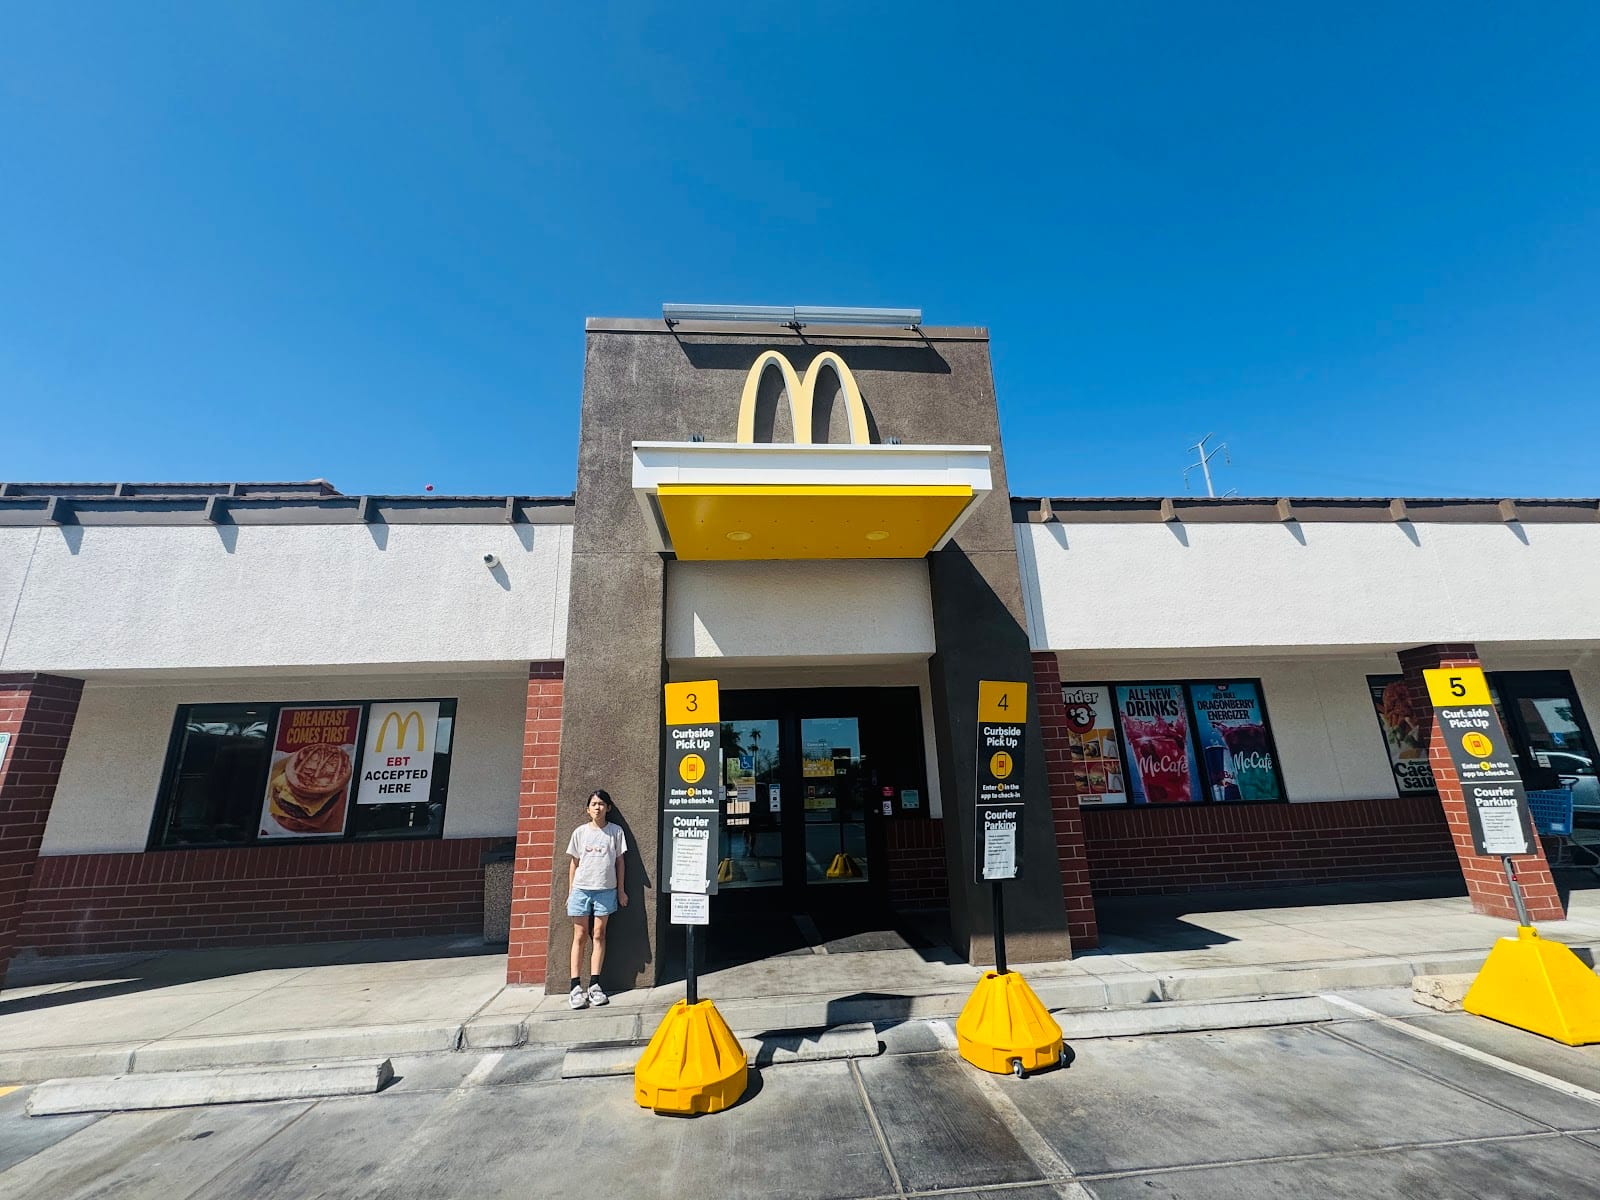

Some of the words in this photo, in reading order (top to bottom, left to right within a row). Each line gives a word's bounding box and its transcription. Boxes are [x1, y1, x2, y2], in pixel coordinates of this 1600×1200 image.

[1450, 677, 1466, 697] 5
[1128, 688, 1171, 700] ALL-NEW
[686, 693, 698, 712] 3
[997, 693, 1009, 711] 4
[1197, 699, 1255, 710] DRAGONBERRY
[1126, 700, 1179, 717] DRINKS
[293, 710, 349, 727] BREAKFAST
[1207, 710, 1250, 720] ENERGIZER
[1449, 719, 1473, 729] Pick
[1474, 719, 1489, 729] Up
[287, 728, 321, 743] COMES
[324, 727, 350, 743] FIRST
[672, 728, 714, 739] Curbside
[983, 726, 1021, 736] Curbside
[676, 740, 696, 750] Pick
[697, 739, 710, 751] Up
[986, 737, 1005, 747] Pick
[1005, 737, 1018, 748] Up
[386, 757, 411, 767] EBT
[365, 769, 428, 781] ACCEPTED
[379, 783, 411, 794] HERE
[671, 788, 687, 796] Enter
[702, 788, 713, 796] the
[1473, 786, 1515, 797] Courier
[669, 798, 681, 806] app
[688, 797, 714, 805] check-in
[1475, 797, 1518, 808] Parking
[985, 809, 1017, 820] Courier
[673, 816, 709, 827] Courier
[984, 820, 1017, 831] Parking
[672, 827, 710, 840] Parking
